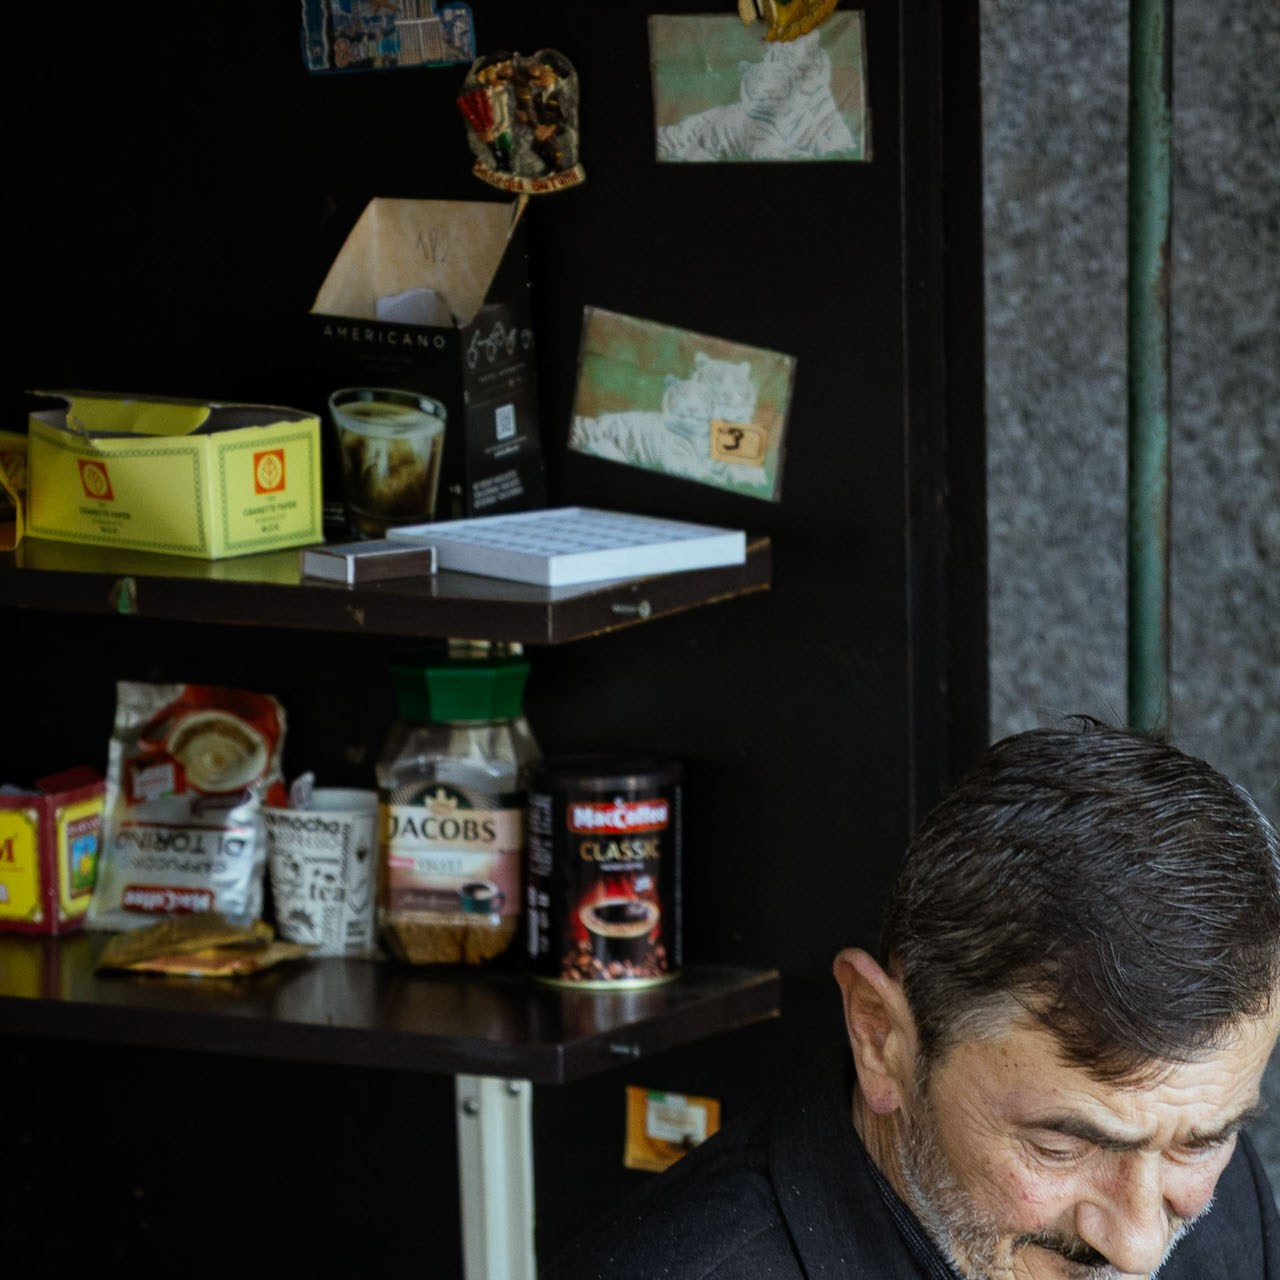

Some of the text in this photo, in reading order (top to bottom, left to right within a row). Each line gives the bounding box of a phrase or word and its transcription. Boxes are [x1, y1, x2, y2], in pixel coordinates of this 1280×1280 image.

[323, 325, 447, 349] AMERICANO
[389, 815, 496, 842] JACOBS
[579, 838, 660, 862] CLASSIC
